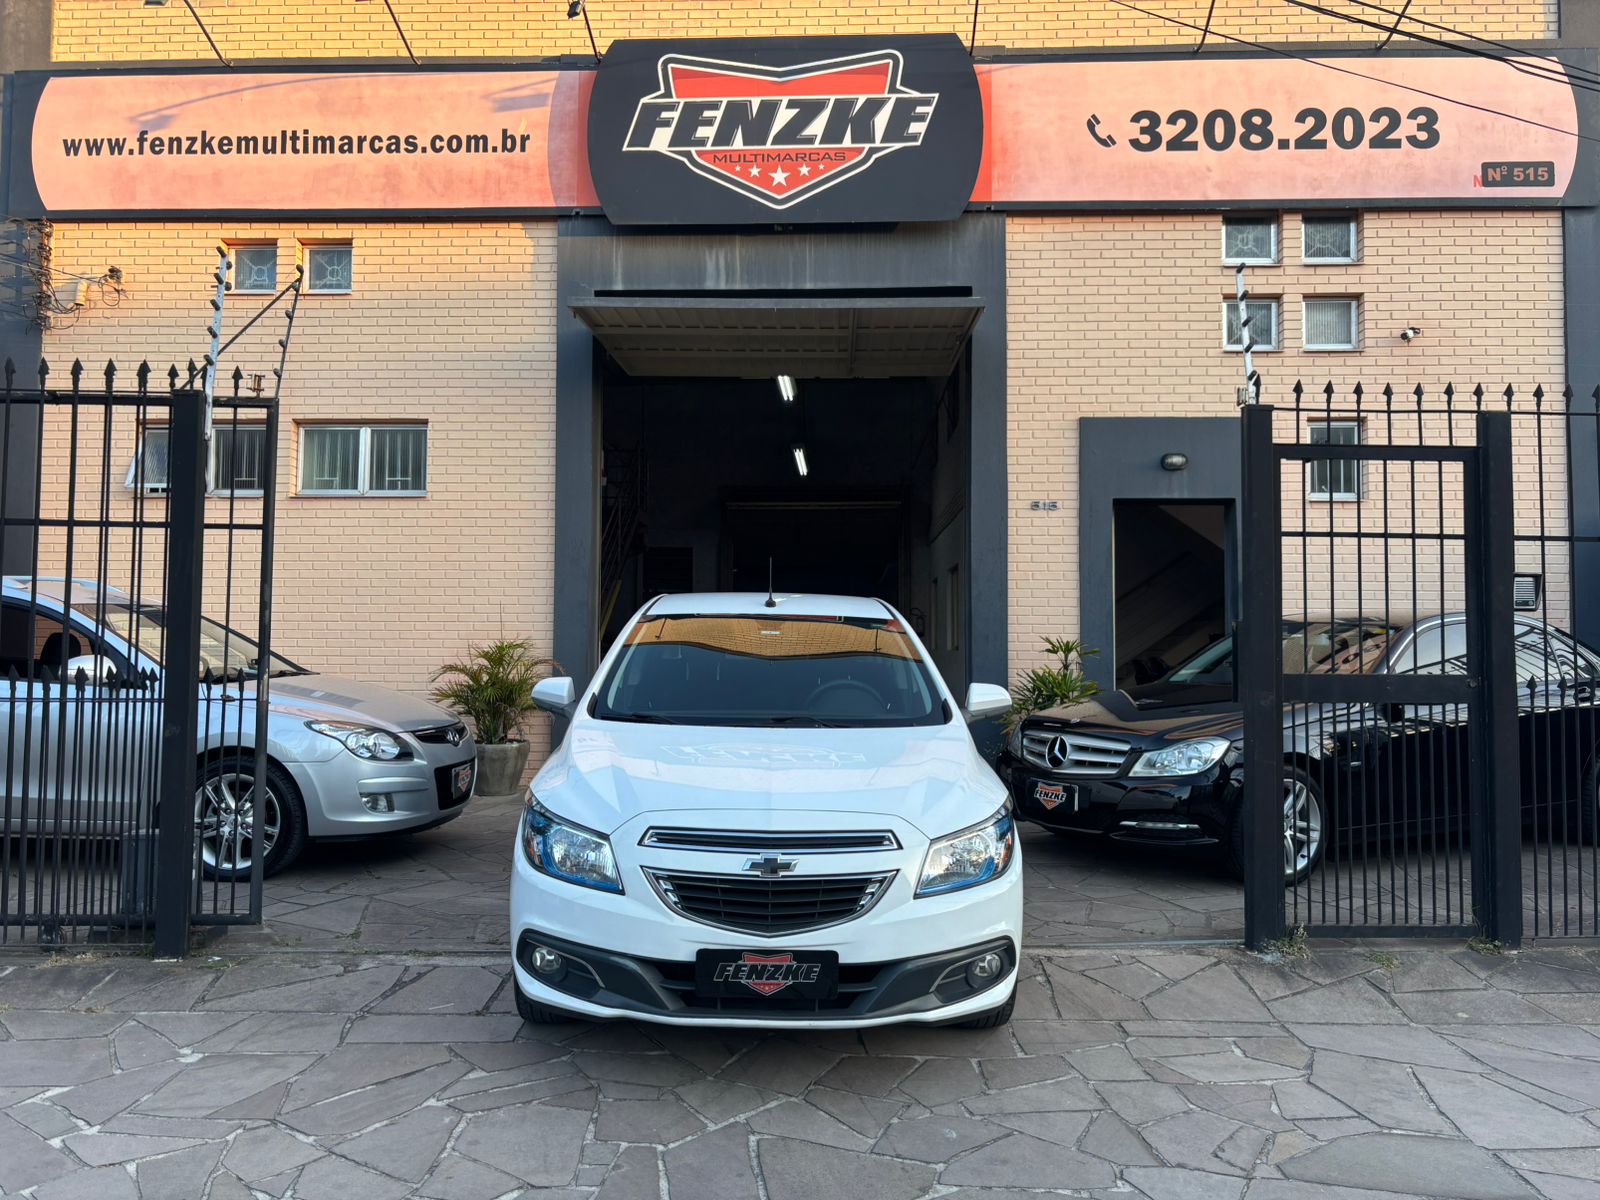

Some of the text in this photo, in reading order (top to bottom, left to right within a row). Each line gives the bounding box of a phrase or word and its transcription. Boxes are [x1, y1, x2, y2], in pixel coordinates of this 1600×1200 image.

[625, 96, 937, 150] FENZKE
[1128, 107, 1441, 152] 3208.2023
[63, 129, 531, 157] www.fenzkemultimarcas.com.br
[712, 151, 846, 164] MULTIMARCAS
[1513, 167, 1549, 182] 515
[1031, 501, 1058, 511] 515
[1034, 788, 1067, 803] FENZKE
[713, 963, 821, 982] FENZKE
